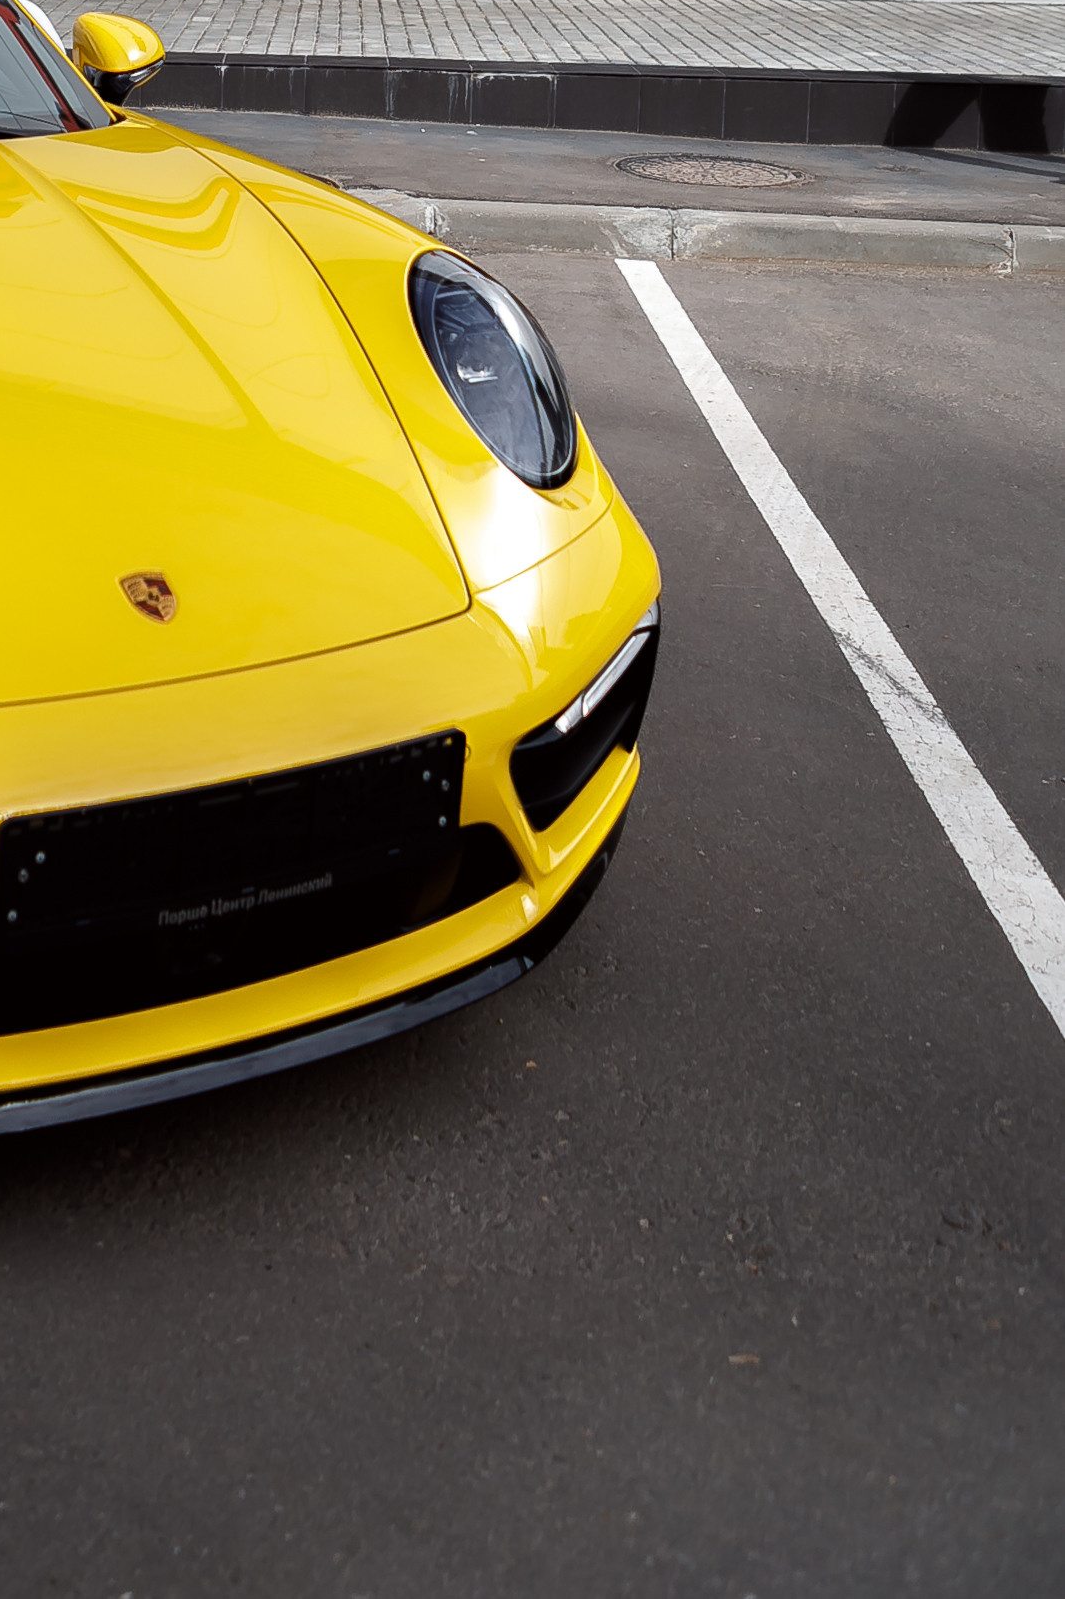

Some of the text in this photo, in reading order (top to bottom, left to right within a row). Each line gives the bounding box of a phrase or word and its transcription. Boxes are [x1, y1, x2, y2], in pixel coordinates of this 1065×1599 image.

[158, 872, 333, 927] Порше Центр Ленинский
